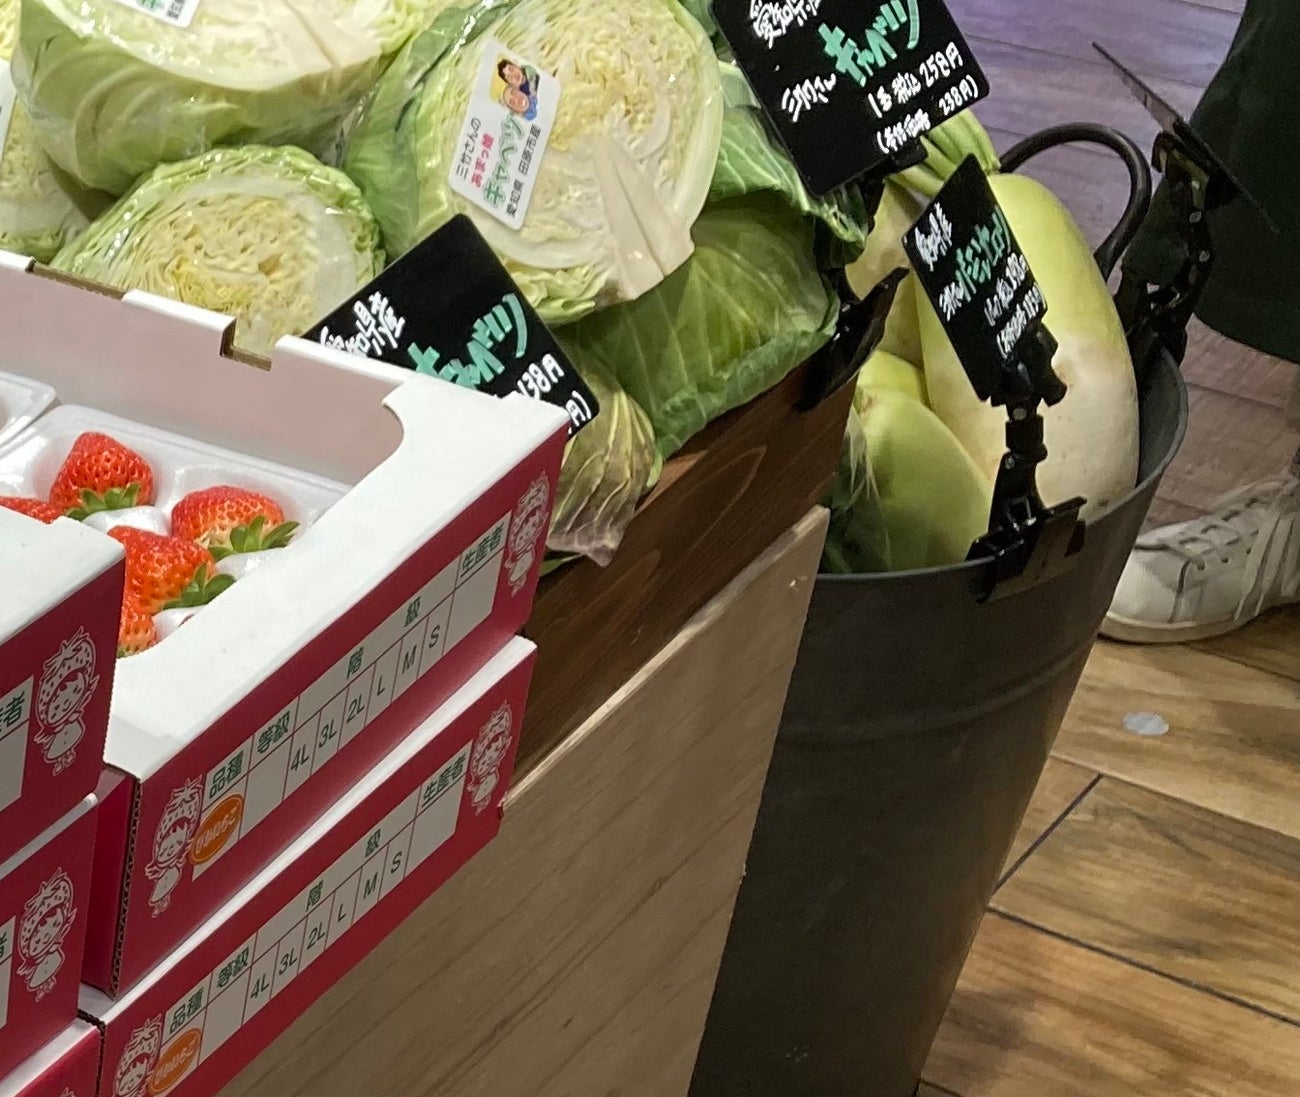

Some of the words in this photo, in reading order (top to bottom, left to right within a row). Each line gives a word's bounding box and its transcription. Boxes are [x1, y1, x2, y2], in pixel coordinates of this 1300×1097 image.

[749, 0, 821, 48] 愛知県
[482, 107, 526, 205] キャベツ
[291, 743, 310, 772] 4L
[318, 718, 338, 748] 3L
[346, 696, 365, 724] 2L
[251, 971, 270, 1001] 4L
[278, 950, 297, 977] 3L
[308, 923, 326, 951] 2L
